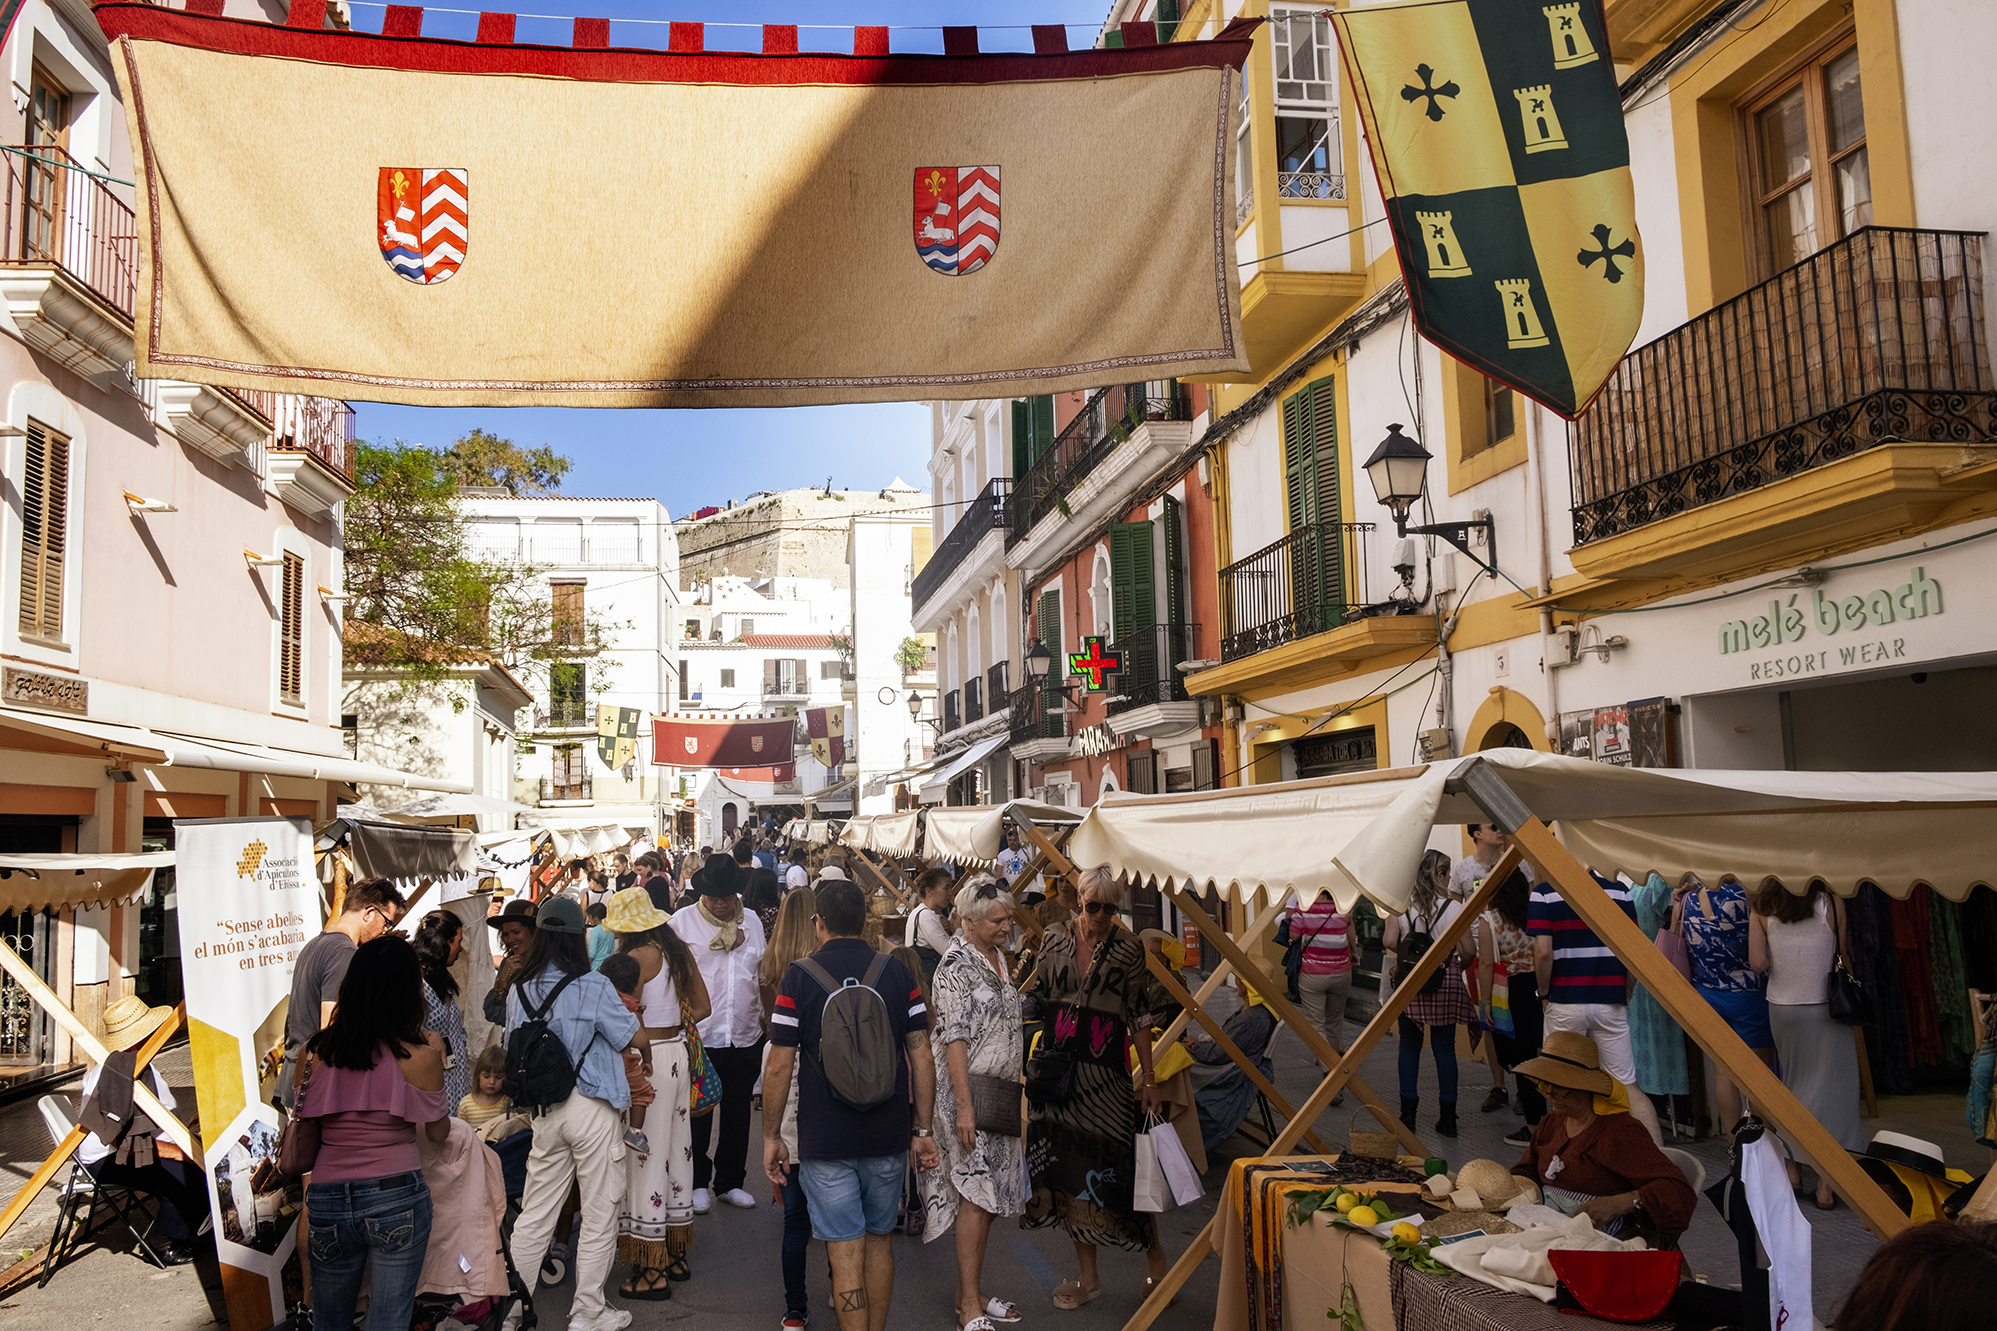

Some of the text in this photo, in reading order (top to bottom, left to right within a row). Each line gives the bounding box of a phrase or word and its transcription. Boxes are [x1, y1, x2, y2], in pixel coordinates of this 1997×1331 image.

[1718, 567, 1944, 655] melé beach
[1750, 638, 1907, 681] RESORT WEAR
[1573, 736, 1590, 752] ANTS
[266, 911, 304, 930] abelles
[194, 928, 306, 960] el món s'acabaria
[239, 957, 255, 971] en
[259, 950, 284, 968] tres
